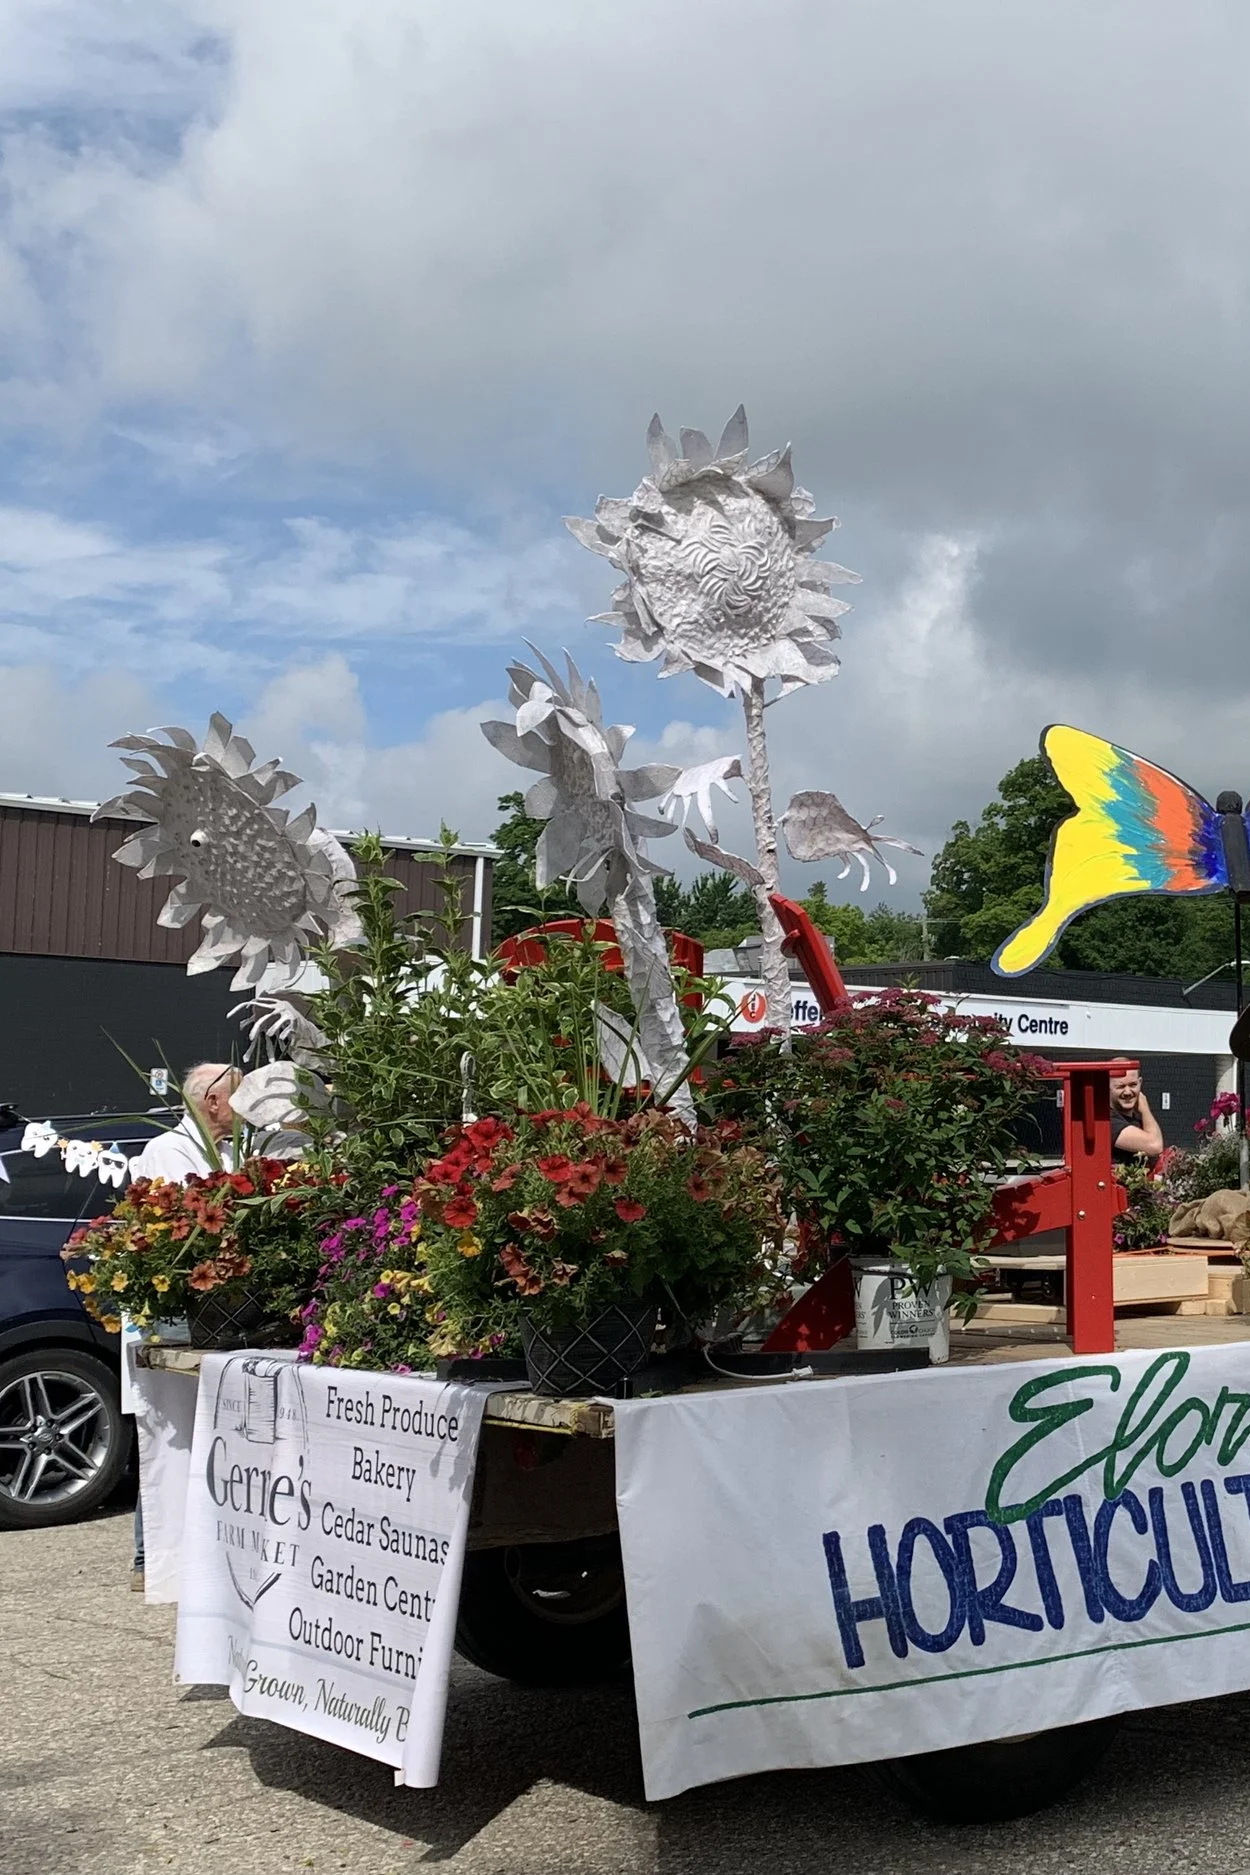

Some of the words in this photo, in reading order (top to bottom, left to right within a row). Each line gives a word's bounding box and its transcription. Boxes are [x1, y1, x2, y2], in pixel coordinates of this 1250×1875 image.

[1018, 1013, 1068, 1035] Centre
[888, 1308, 934, 1319] WINNERS
[892, 1299, 930, 1310] PROVEN
[279, 1406, 298, 1421] 948
[326, 1385, 375, 1426] Fresh
[380, 1394, 459, 1442] Produce
[351, 1446, 417, 1502] Bakery
[251, 1529, 300, 1567] MKET
[321, 1501, 375, 1547] Cedar
[379, 1515, 450, 1566] Saunas
[311, 1555, 378, 1607] Garden
[383, 1576, 436, 1622] Cent
[289, 1606, 364, 1661] Outdoor
[243, 1659, 308, 1713] Grown,
[314, 1678, 392, 1744] Naturally
